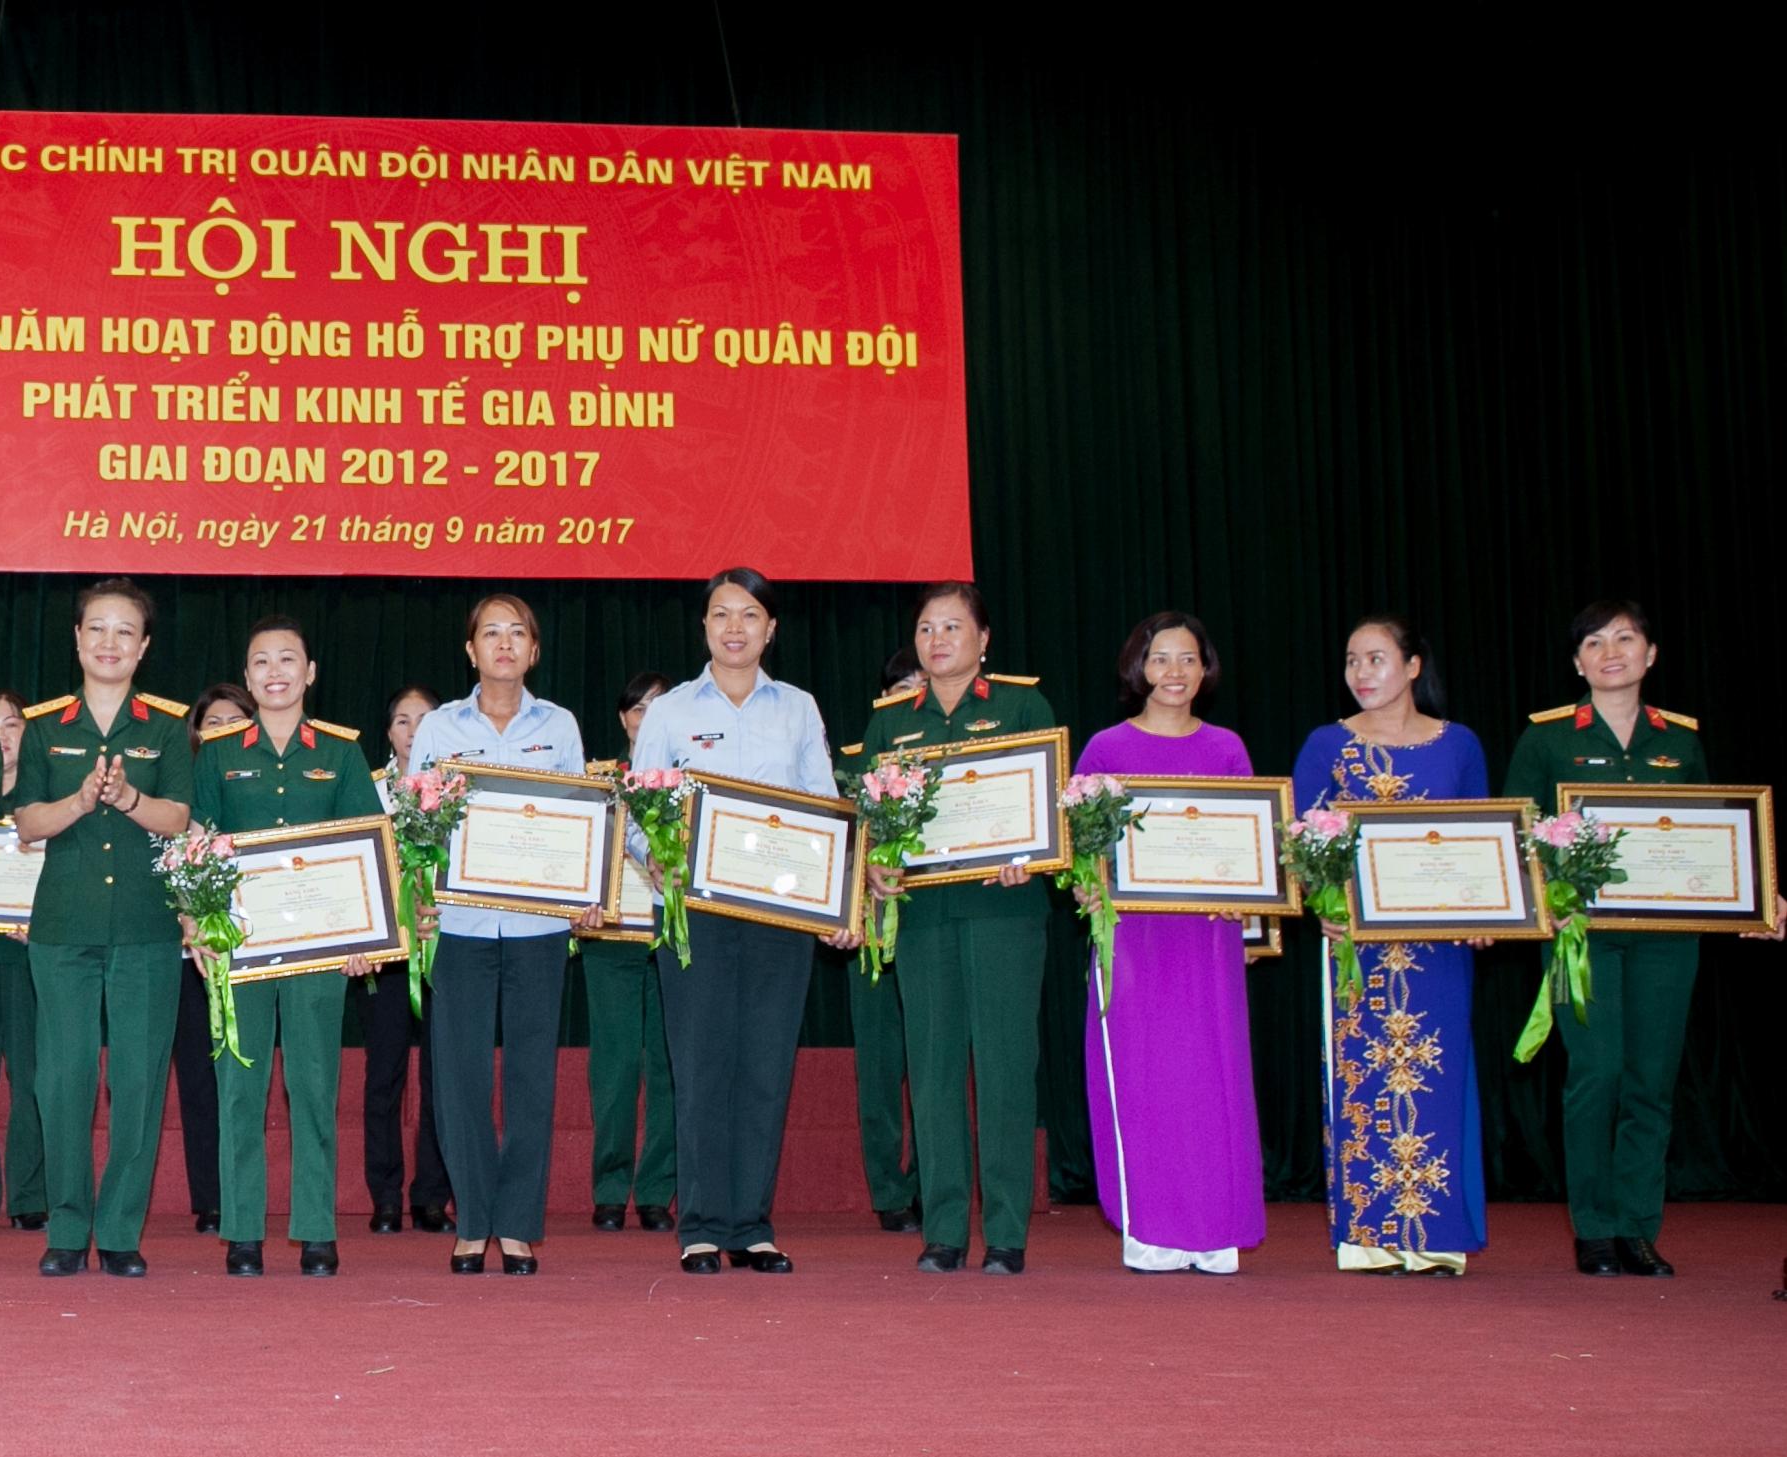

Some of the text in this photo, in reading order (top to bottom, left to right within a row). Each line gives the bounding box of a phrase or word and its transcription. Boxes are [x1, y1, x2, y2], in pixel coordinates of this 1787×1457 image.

[40, 139, 163, 173] CHÍNH
[176, 147, 236, 183] TRỊ
[250, 143, 366, 177] QUÂN
[379, 145, 448, 187] ĐỘI
[462, 148, 575, 182] NHÂN
[589, 151, 673, 185] DÂN
[686, 153, 770, 194] VIỆT
[782, 162, 871, 190] NAM
[110, 196, 588, 304] HỘI NGHỊ
[101, 317, 216, 363] HOẠT
[228, 312, 351, 365] ĐỘNG
[367, 308, 424, 359] HỖ
[438, 321, 525, 369] TRỢ
[537, 325, 624, 370] PHỤ
[639, 318, 705, 363] NỮ
[714, 322, 832, 368] QUÂN
[845, 324, 918, 375] ĐỘI
[22, 370, 674, 428] PHÁT TRIỂN KINH TẾ GIA ĐÌNH
[98, 443, 600, 492] GIAI ĐOẠN 2012 - 2017
[63, 509, 635, 550] Hà Nội, ngày 21 tháng 9 năm 2017
